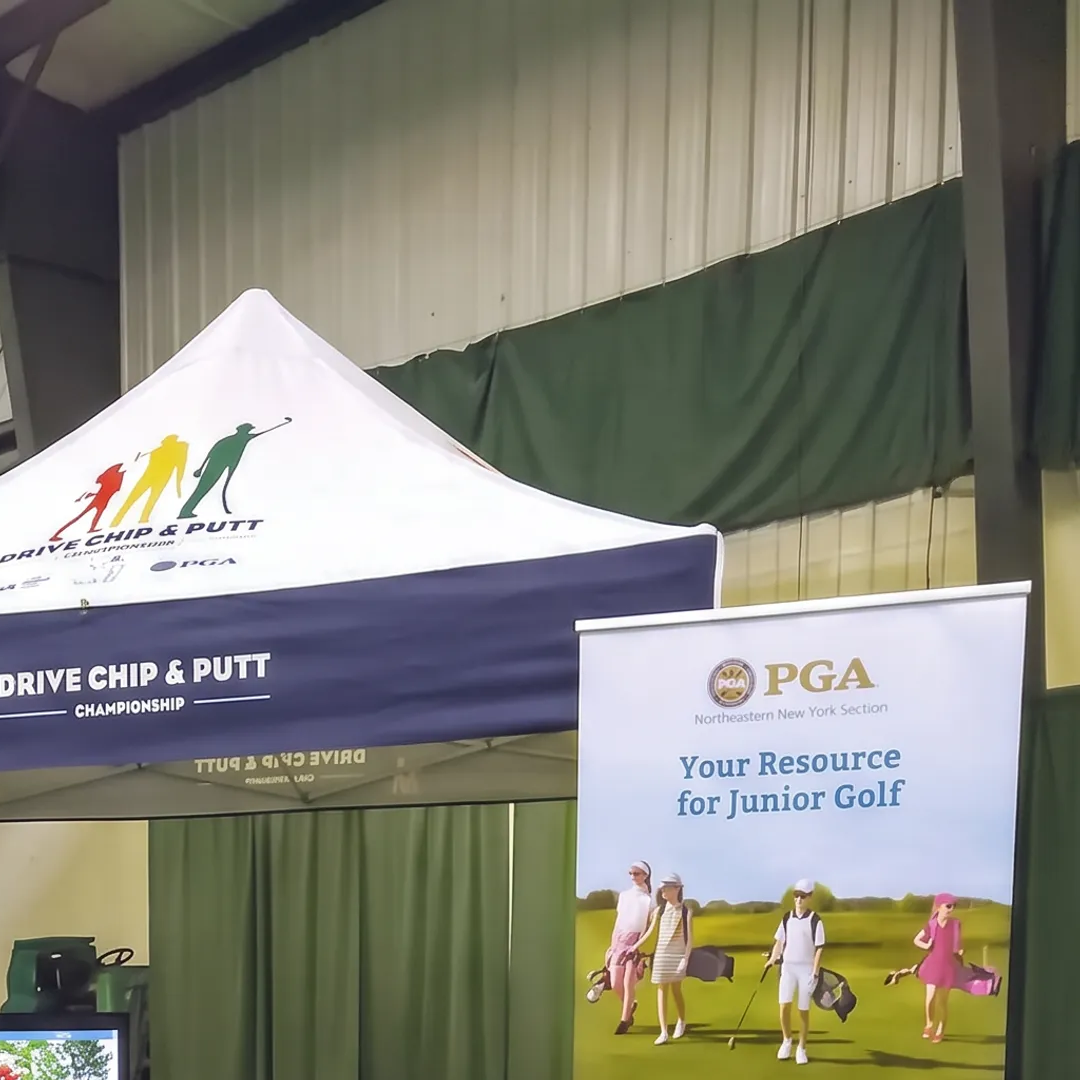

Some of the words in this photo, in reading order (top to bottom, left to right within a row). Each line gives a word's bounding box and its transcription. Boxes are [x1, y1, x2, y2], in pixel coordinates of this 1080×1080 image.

[0, 539, 82, 564] DRIVE
[85, 527, 152, 547] CHIP
[158, 524, 178, 536] &
[185, 519, 264, 535] PUTT
[179, 557, 237, 569] PGA
[88, 661, 159, 691] CHIP
[165, 659, 186, 685] &
[193, 652, 271, 683] PUTT
[763, 657, 875, 697] PGA
[74, 697, 185, 719] CHAMPIONSHIP
[694, 710, 774, 726] Northeastern
[777, 707, 806, 721] New
[808, 704, 837, 719] York
[840, 702, 889, 716] Section
[679, 755, 750, 780] Your
[758, 748, 901, 776] Resource
[677, 789, 720, 817] for
[726, 784, 826, 820] Junior
[834, 779, 906, 810] Golf
